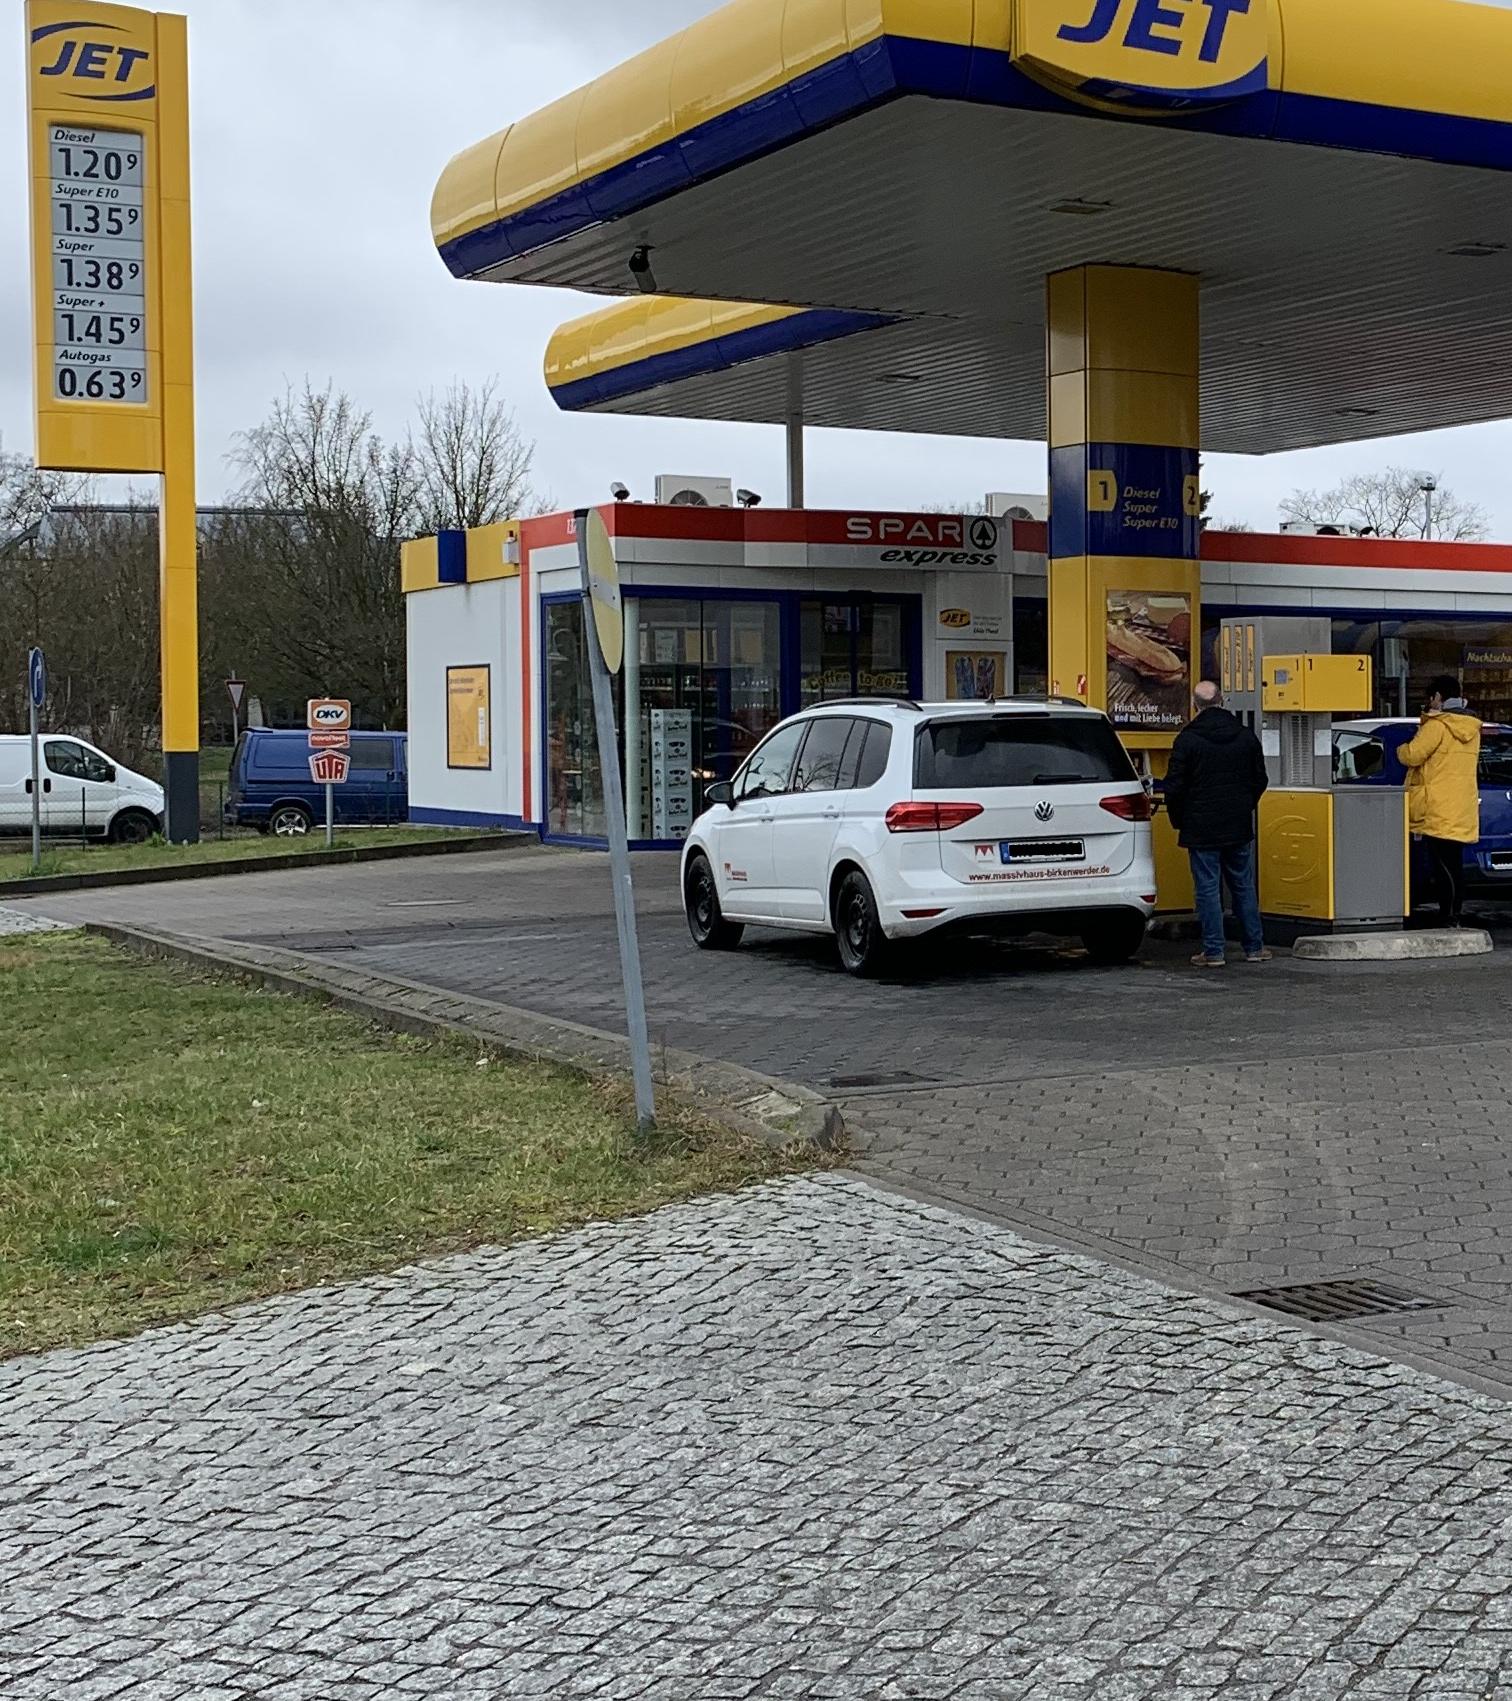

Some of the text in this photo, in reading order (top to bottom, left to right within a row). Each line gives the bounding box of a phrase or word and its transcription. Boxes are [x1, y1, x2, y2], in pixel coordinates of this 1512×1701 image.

[1056, 0, 1250, 64] JET
[39, 40, 150, 82] JET
[54, 129, 96, 143] Diesel
[55, 183, 119, 199] Super E10
[56, 239, 95, 253] Super
[57, 294, 95, 308] Super
[59, 349, 112, 365] Autogas
[1099, 480, 1108, 501] 1
[1123, 486, 1161, 499] Diesel
[1187, 485, 1196, 506] 2
[1122, 501, 1158, 516] Super
[846, 517, 961, 543] SPAR
[1122, 516, 1179, 531] Super E10
[880, 549, 998, 567] express
[943, 613, 968, 624] JET
[1357, 659, 1365, 672] 2
[316, 710, 344, 719] DKV
[315, 754, 346, 779] UTA
[968, 864, 1110, 881] www.massivhaus-birkenwerder.de
